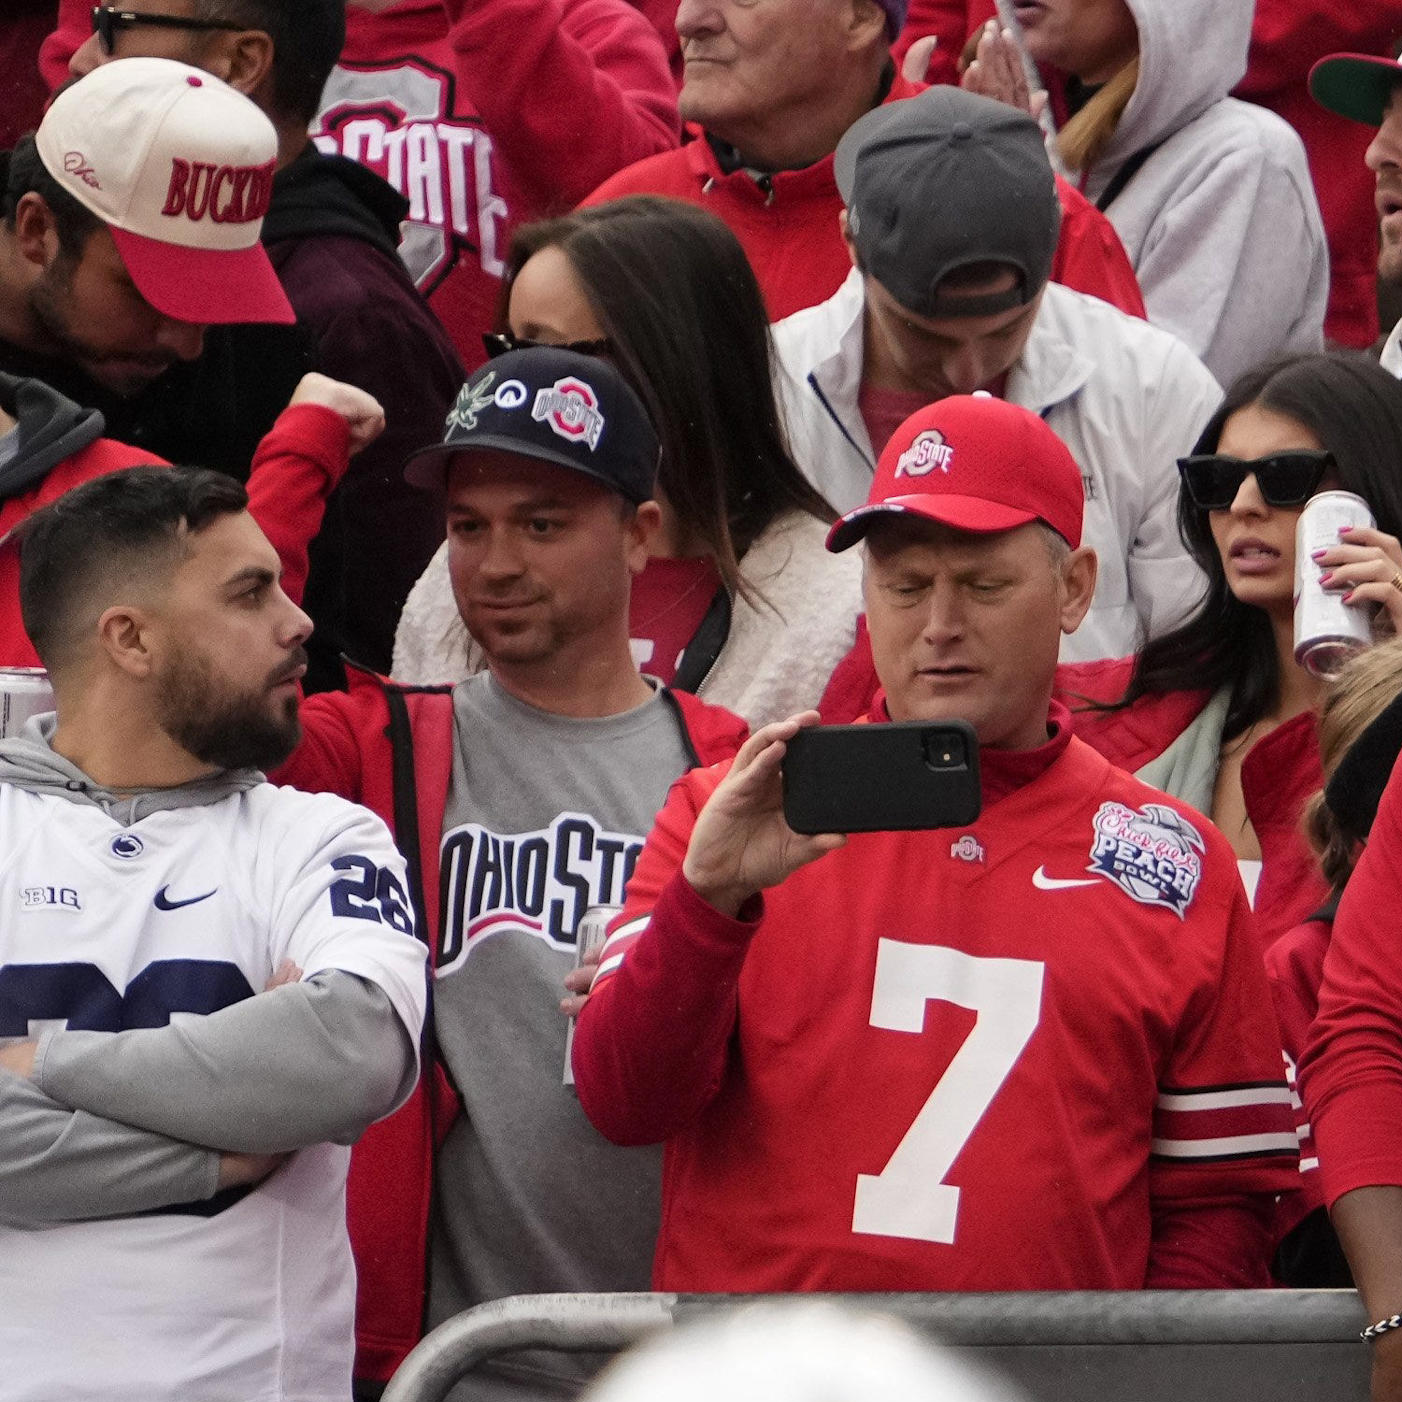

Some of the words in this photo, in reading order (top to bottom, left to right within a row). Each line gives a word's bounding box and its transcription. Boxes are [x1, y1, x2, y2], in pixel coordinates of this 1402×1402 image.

[329, 854, 414, 937] 26
[435, 829, 550, 968] OHIO
[1095, 836, 1195, 900] PEACH
[1113, 860, 1170, 895] BOWL
[851, 937, 1045, 1246] 7
